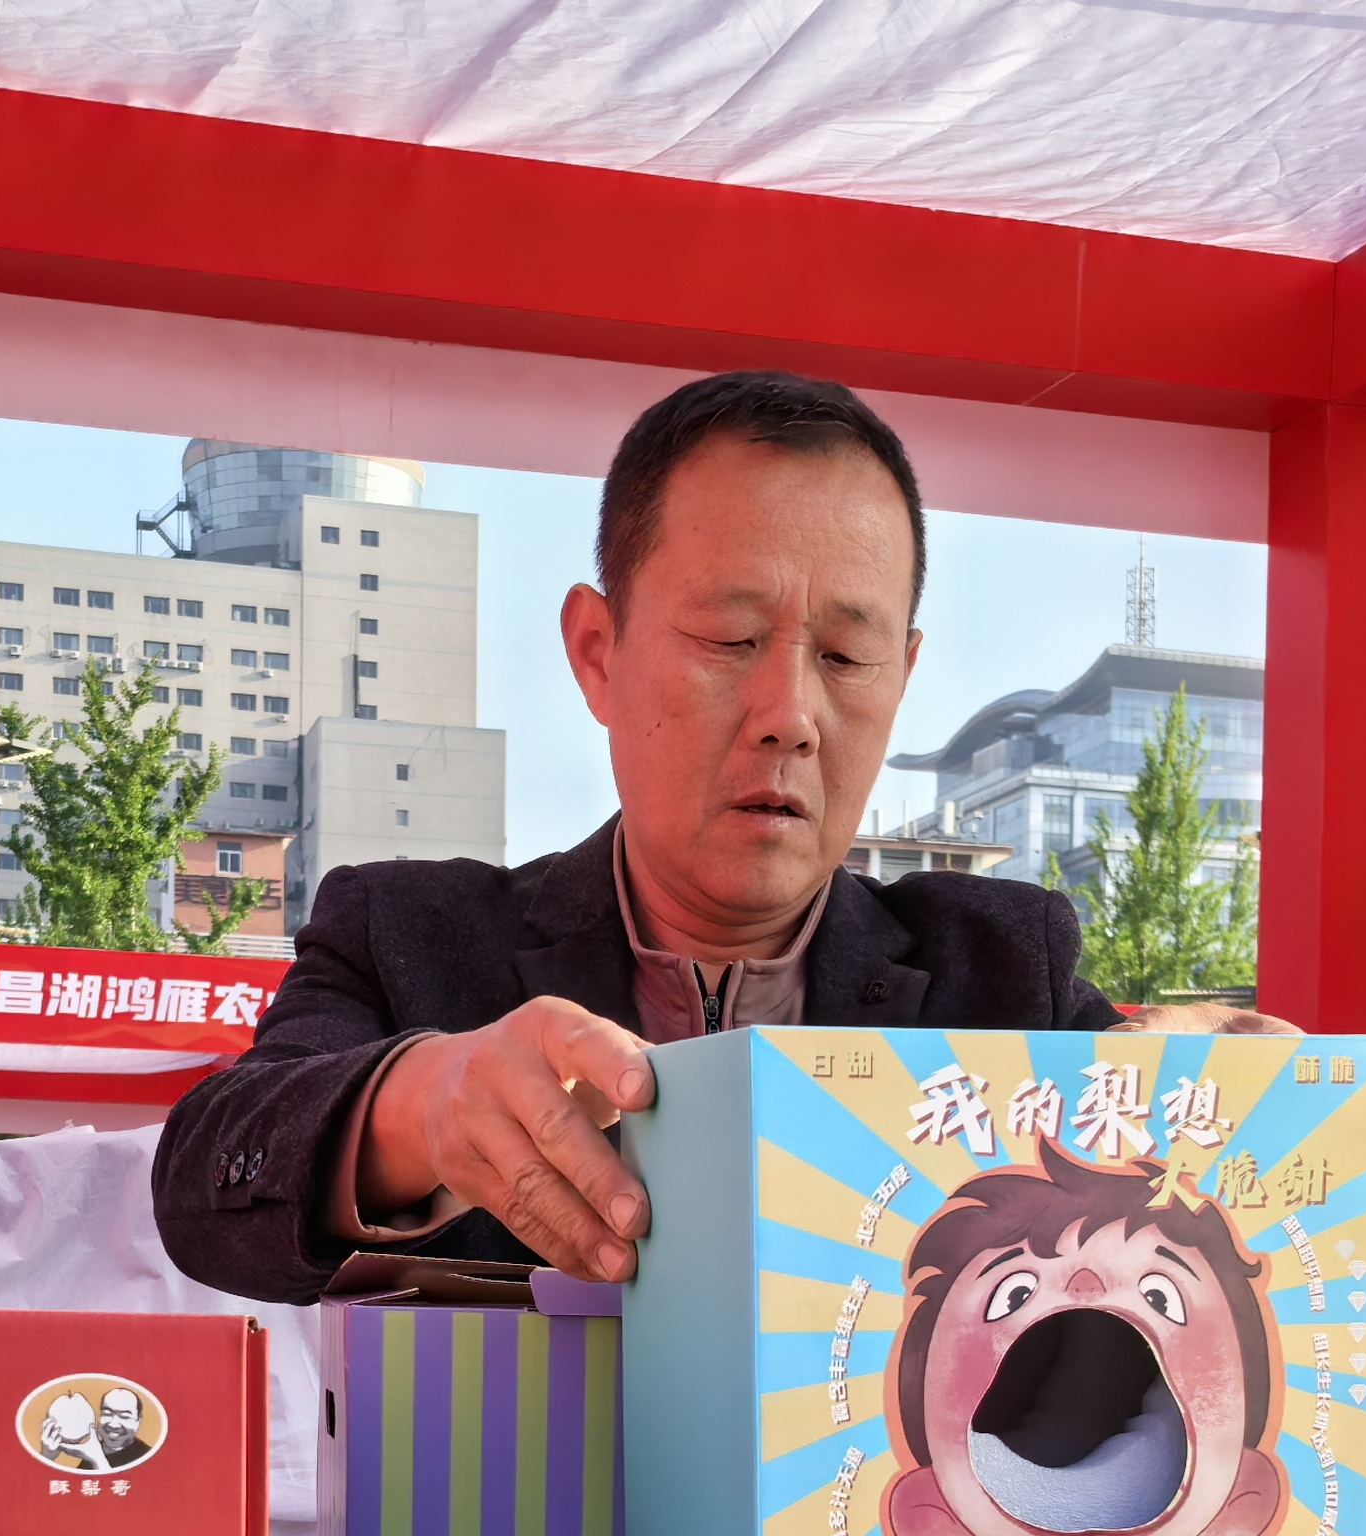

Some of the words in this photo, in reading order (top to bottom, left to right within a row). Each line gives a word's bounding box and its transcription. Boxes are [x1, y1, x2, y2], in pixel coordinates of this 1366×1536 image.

[810, 1047, 874, 1078] 甘甜
[1295, 1055, 1355, 1084] 酥脆
[906, 1060, 1233, 1157] 我的梨想
[1145, 1148, 1334, 1214] 大脆甜
